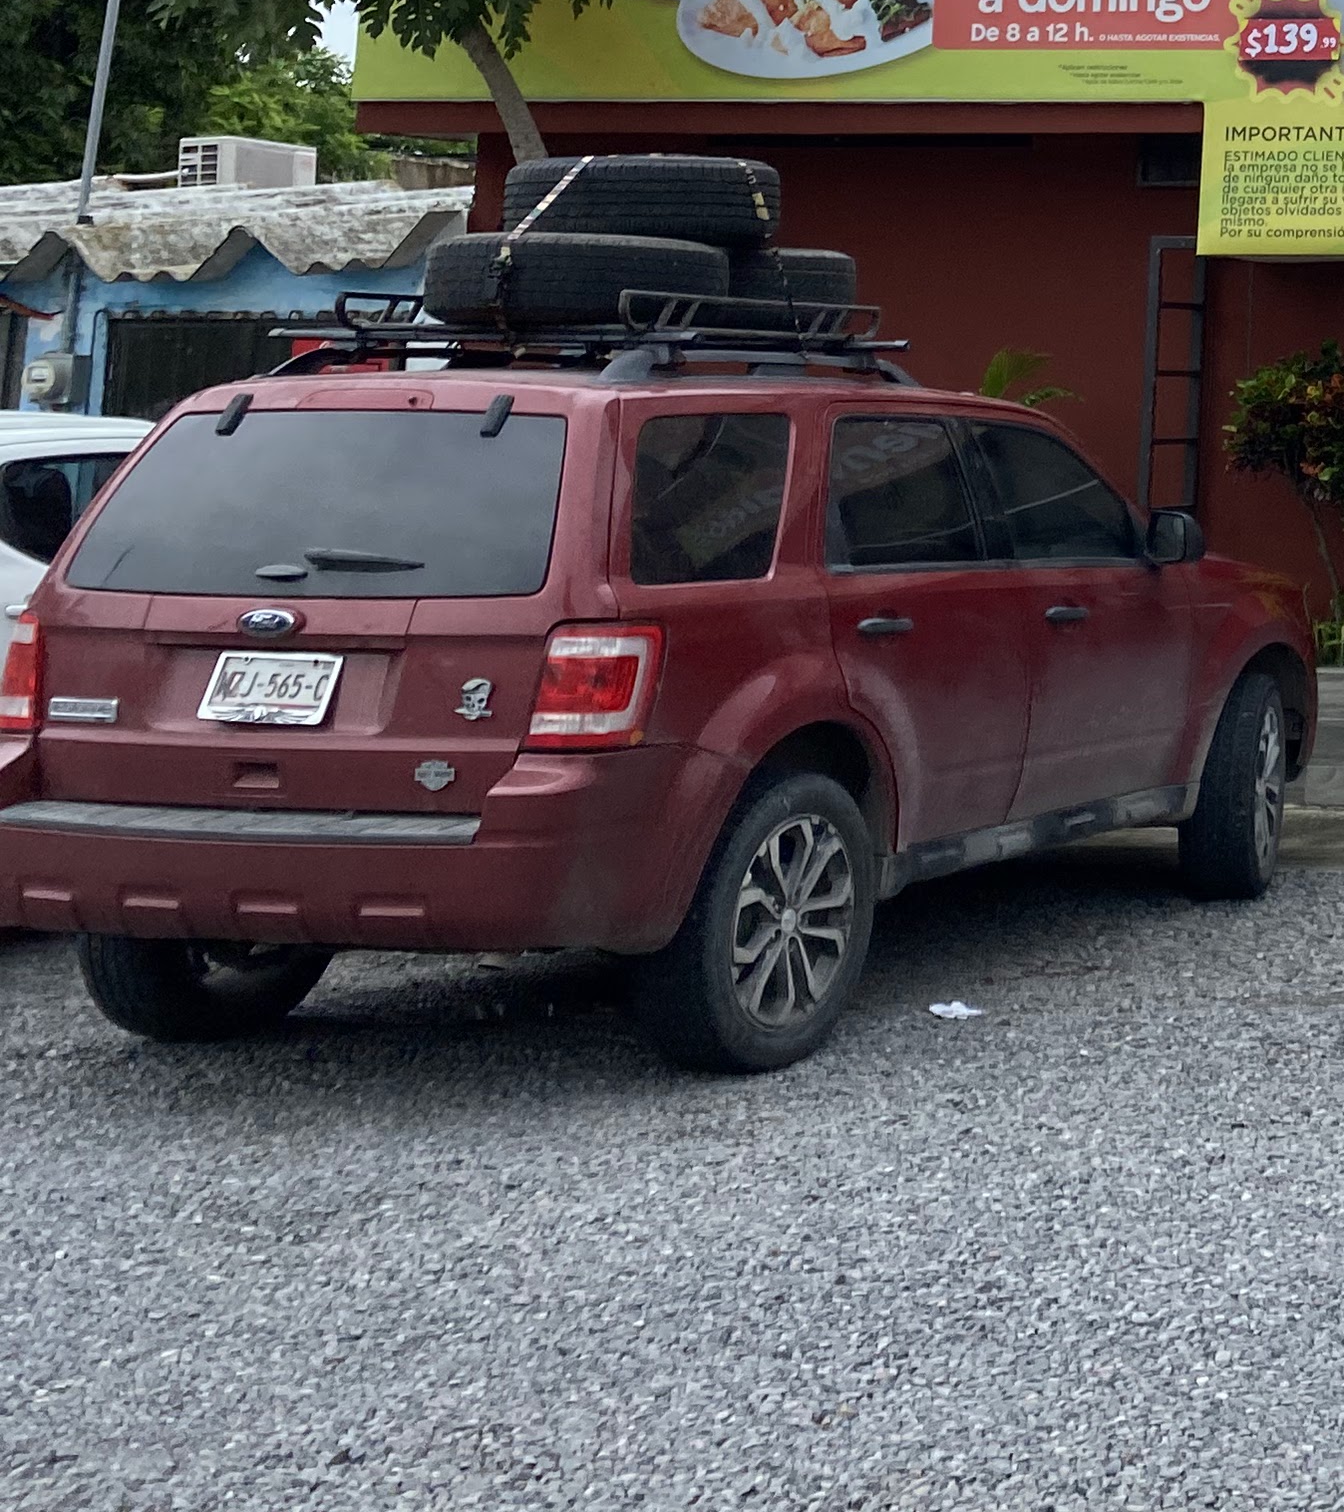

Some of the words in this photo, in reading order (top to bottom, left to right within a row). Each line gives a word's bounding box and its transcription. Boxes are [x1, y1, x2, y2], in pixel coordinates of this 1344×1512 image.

[970, 24, 1000, 42] De
[1005, 23, 1021, 42] 8
[1026, 27, 1040, 42] a
[1045, 23, 1069, 43] 12
[1074, 23, 1094, 42] h.
[1107, 34, 1133, 42] HASTA
[1135, 34, 1167, 42] AGOTAR
[1224, 150, 1298, 162] ESTIMADO
[1223, 161, 1234, 173] la
[1239, 164, 1297, 176] empresa
[1302, 164, 1318, 173] no
[1323, 164, 1337, 173] se
[1223, 172, 1239, 184] de
[1244, 172, 1290, 187] ningún
[1294, 172, 1327, 183] daño
[1222, 183, 1239, 194] de
[1243, 183, 1304, 197] cualquier
[1310, 184, 1337, 194] otra
[1222, 194, 1267, 208] llegara
[1272, 196, 1279, 205] a
[1284, 194, 1318, 208] sufrir
[1323, 196, 1338, 205] su
[1221, 205, 1271, 218] objetos
[1276, 205, 1342, 216] olvidados
[1220, 216, 1267, 227] mismo.
[1220, 226, 1242, 238] Por
[1247, 228, 1261, 238] su
